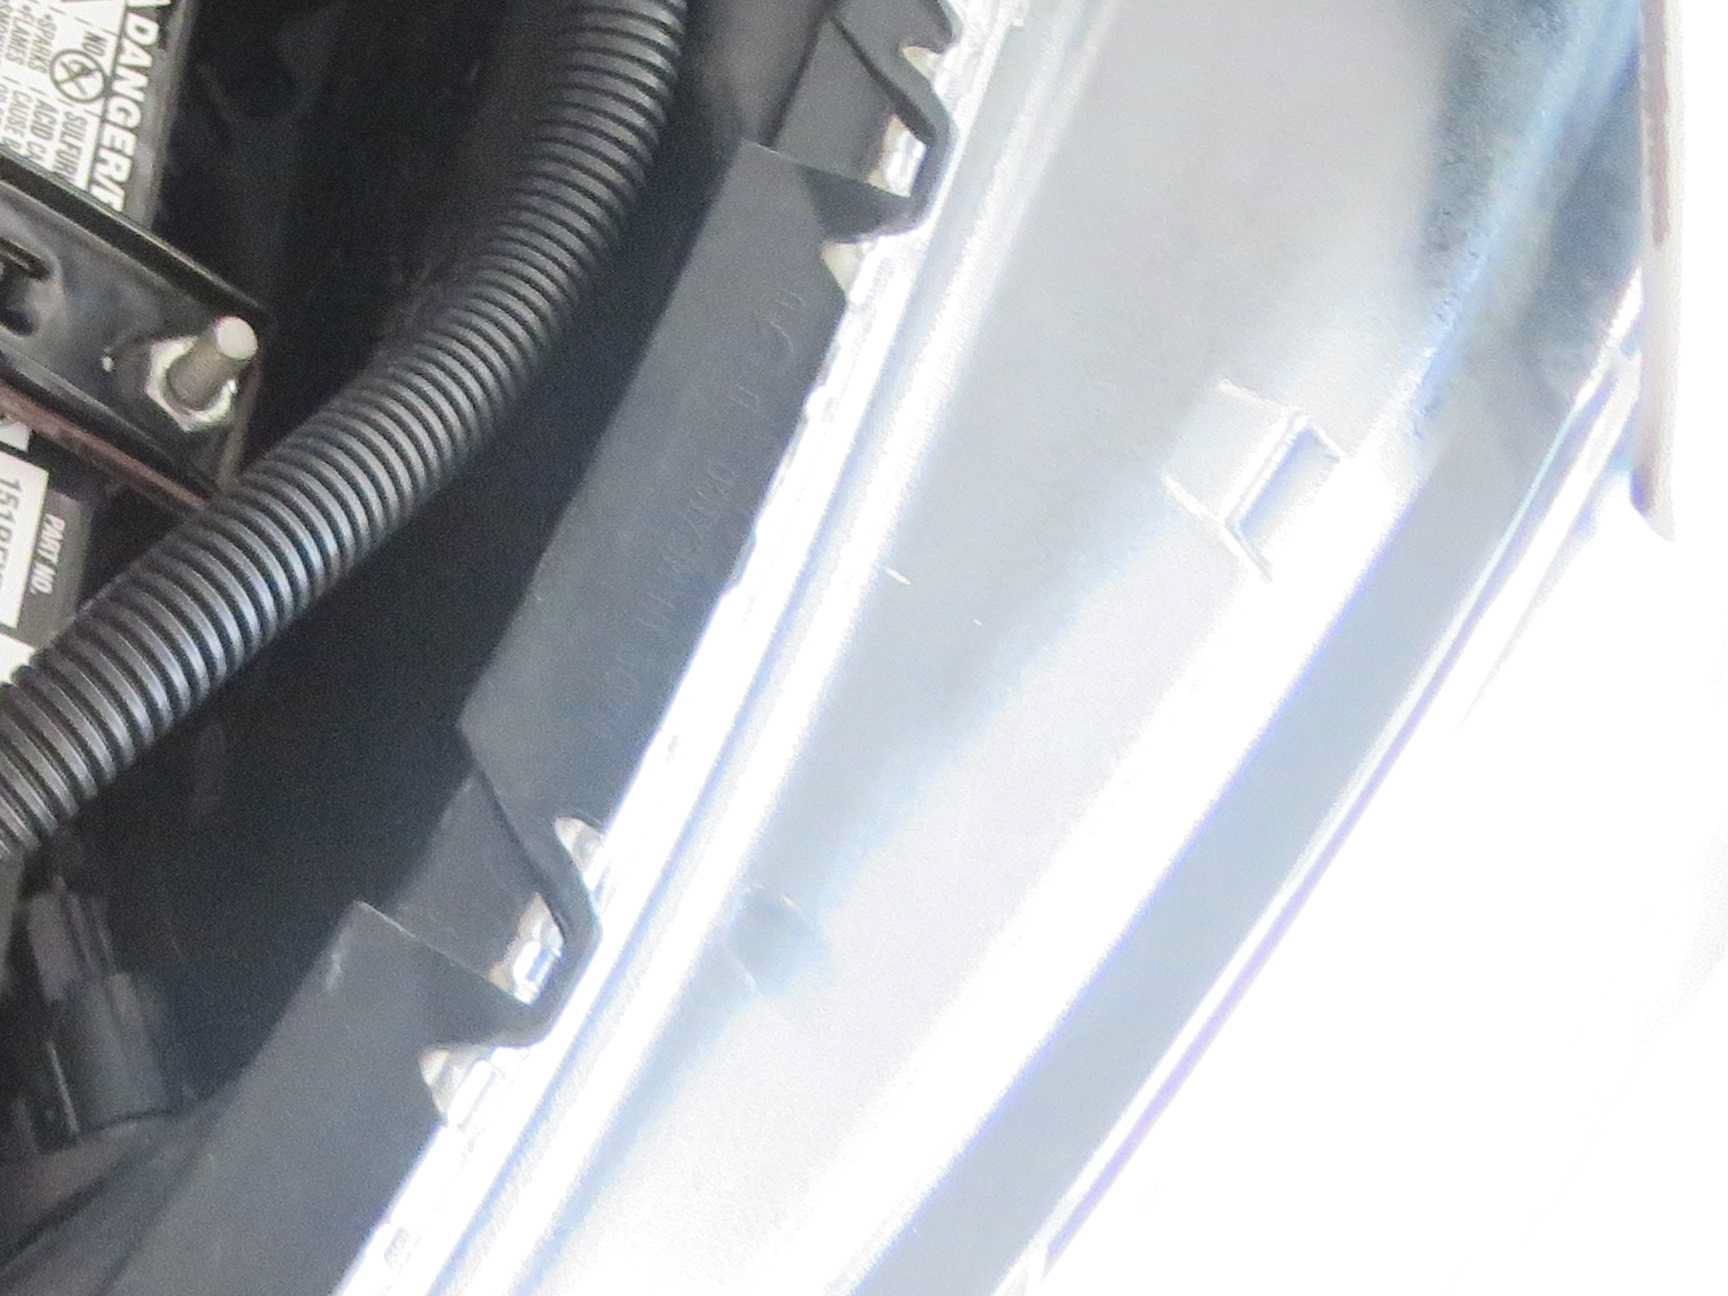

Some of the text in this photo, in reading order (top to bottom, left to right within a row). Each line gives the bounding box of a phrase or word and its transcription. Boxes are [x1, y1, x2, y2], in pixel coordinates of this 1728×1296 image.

[78, 29, 108, 59] NO
[2, 87, 35, 139] CAUSE
[20, 98, 60, 169] ACID CA
[27, 510, 67, 602] PART NO.
